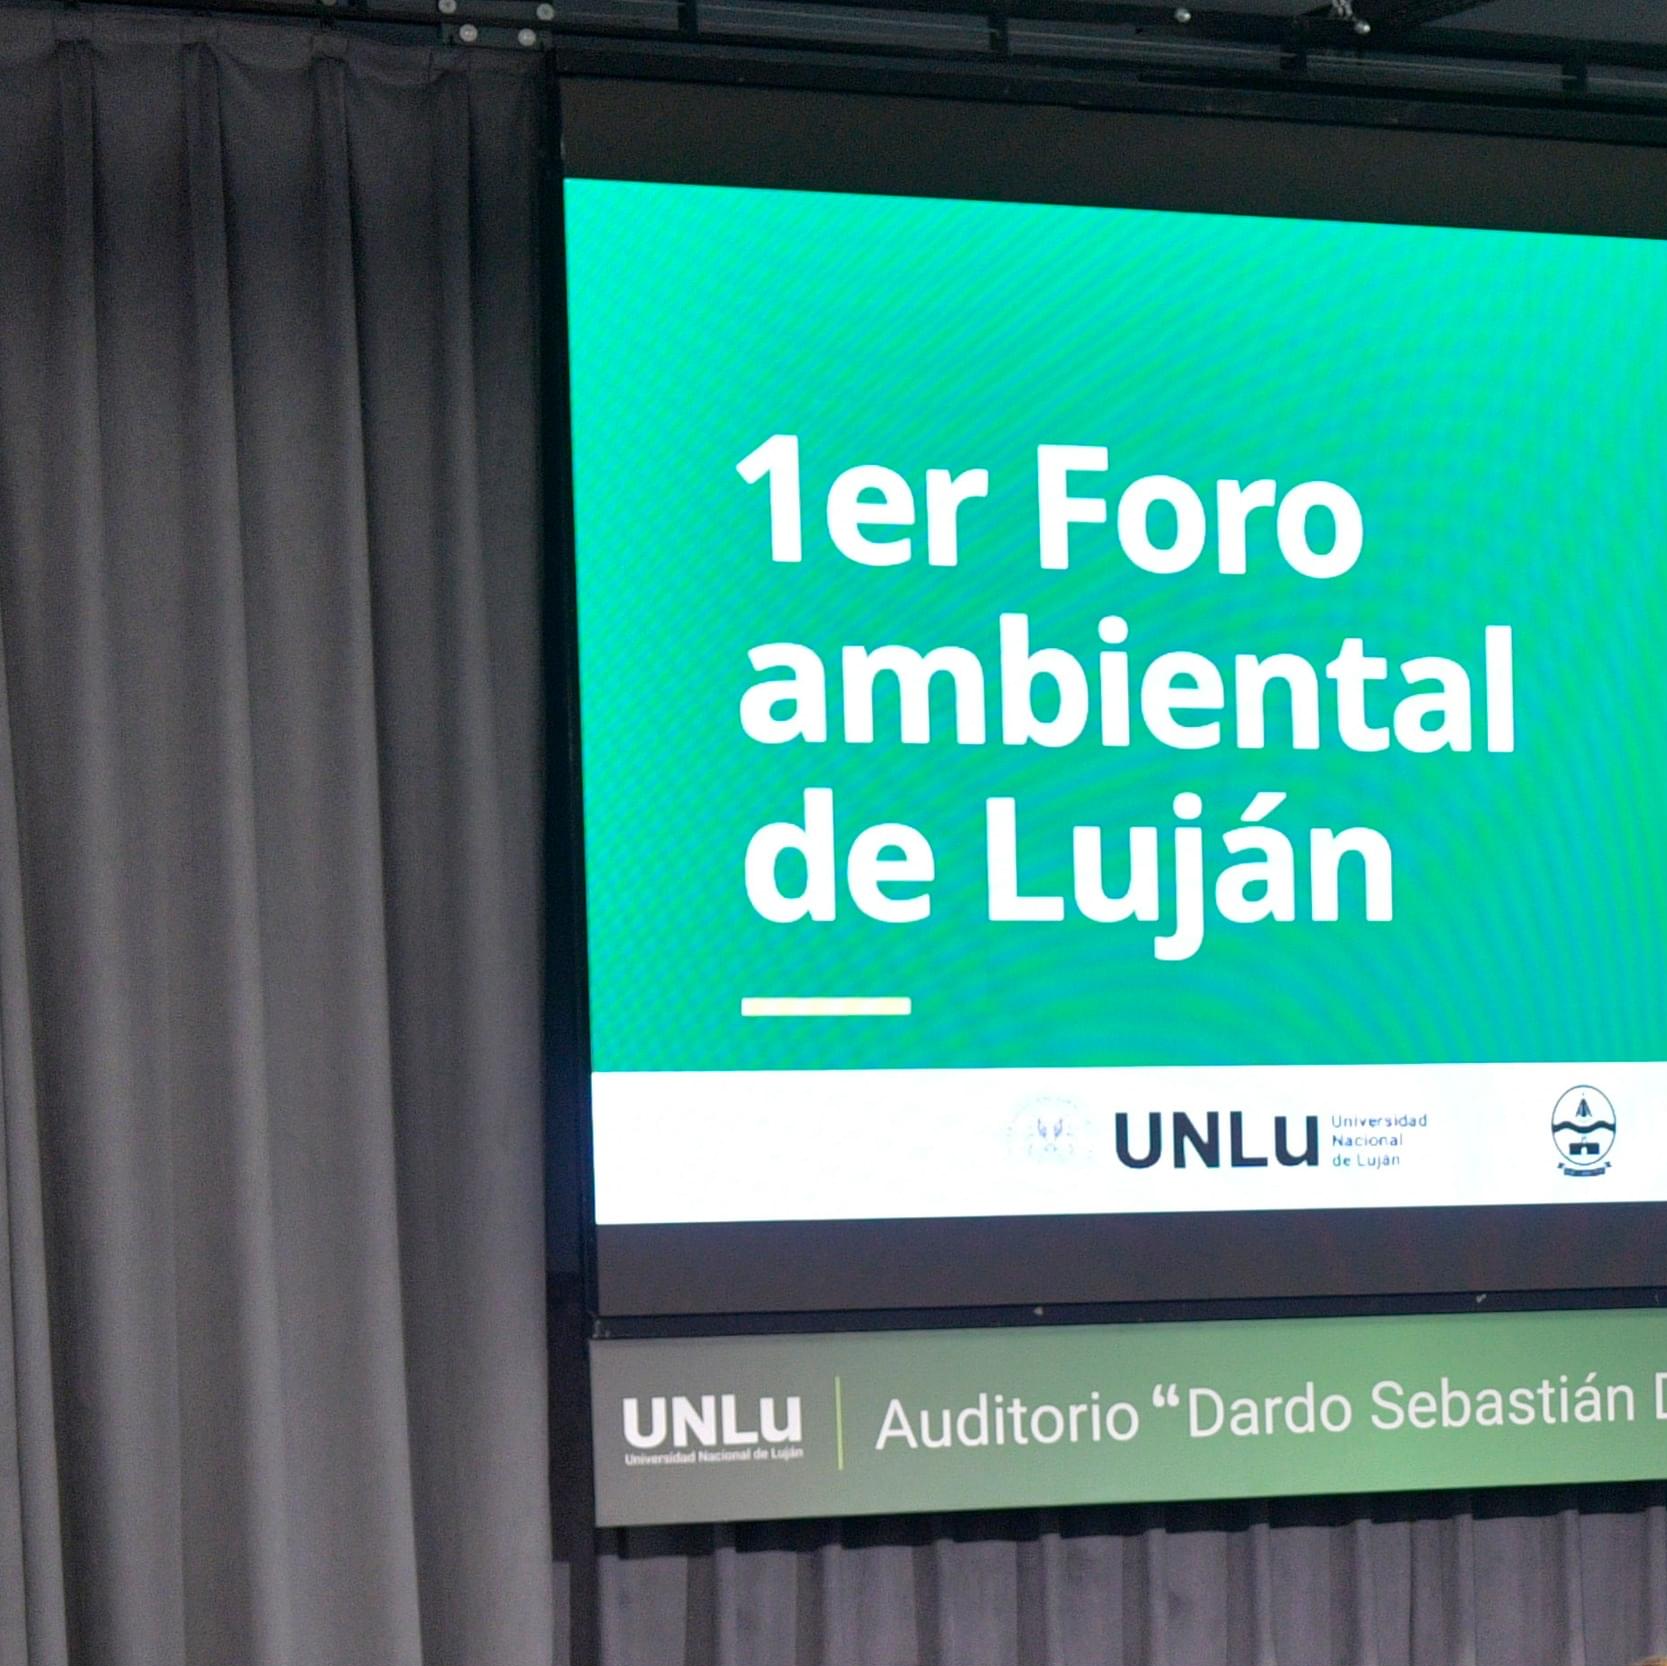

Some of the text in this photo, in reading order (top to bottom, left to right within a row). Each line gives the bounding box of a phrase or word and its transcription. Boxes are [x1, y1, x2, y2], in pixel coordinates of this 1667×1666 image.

[735, 433, 1364, 579] 1er Foro
[739, 612, 1515, 754] ambiental
[743, 787, 1394, 962] de Luján
[1114, 1110, 1320, 1170] UNLu
[1330, 1113, 1428, 1129] Universidad
[1330, 1133, 1403, 1148] Nacional
[1331, 1153, 1401, 1170] de Luján
[622, 1393, 803, 1450] UNLu
[875, 1392, 1140, 1451] Auditorio
[1371, 1371, 1636, 1431] Sebastián
[624, 1445, 805, 1467] Universidad Nacional de Luján
